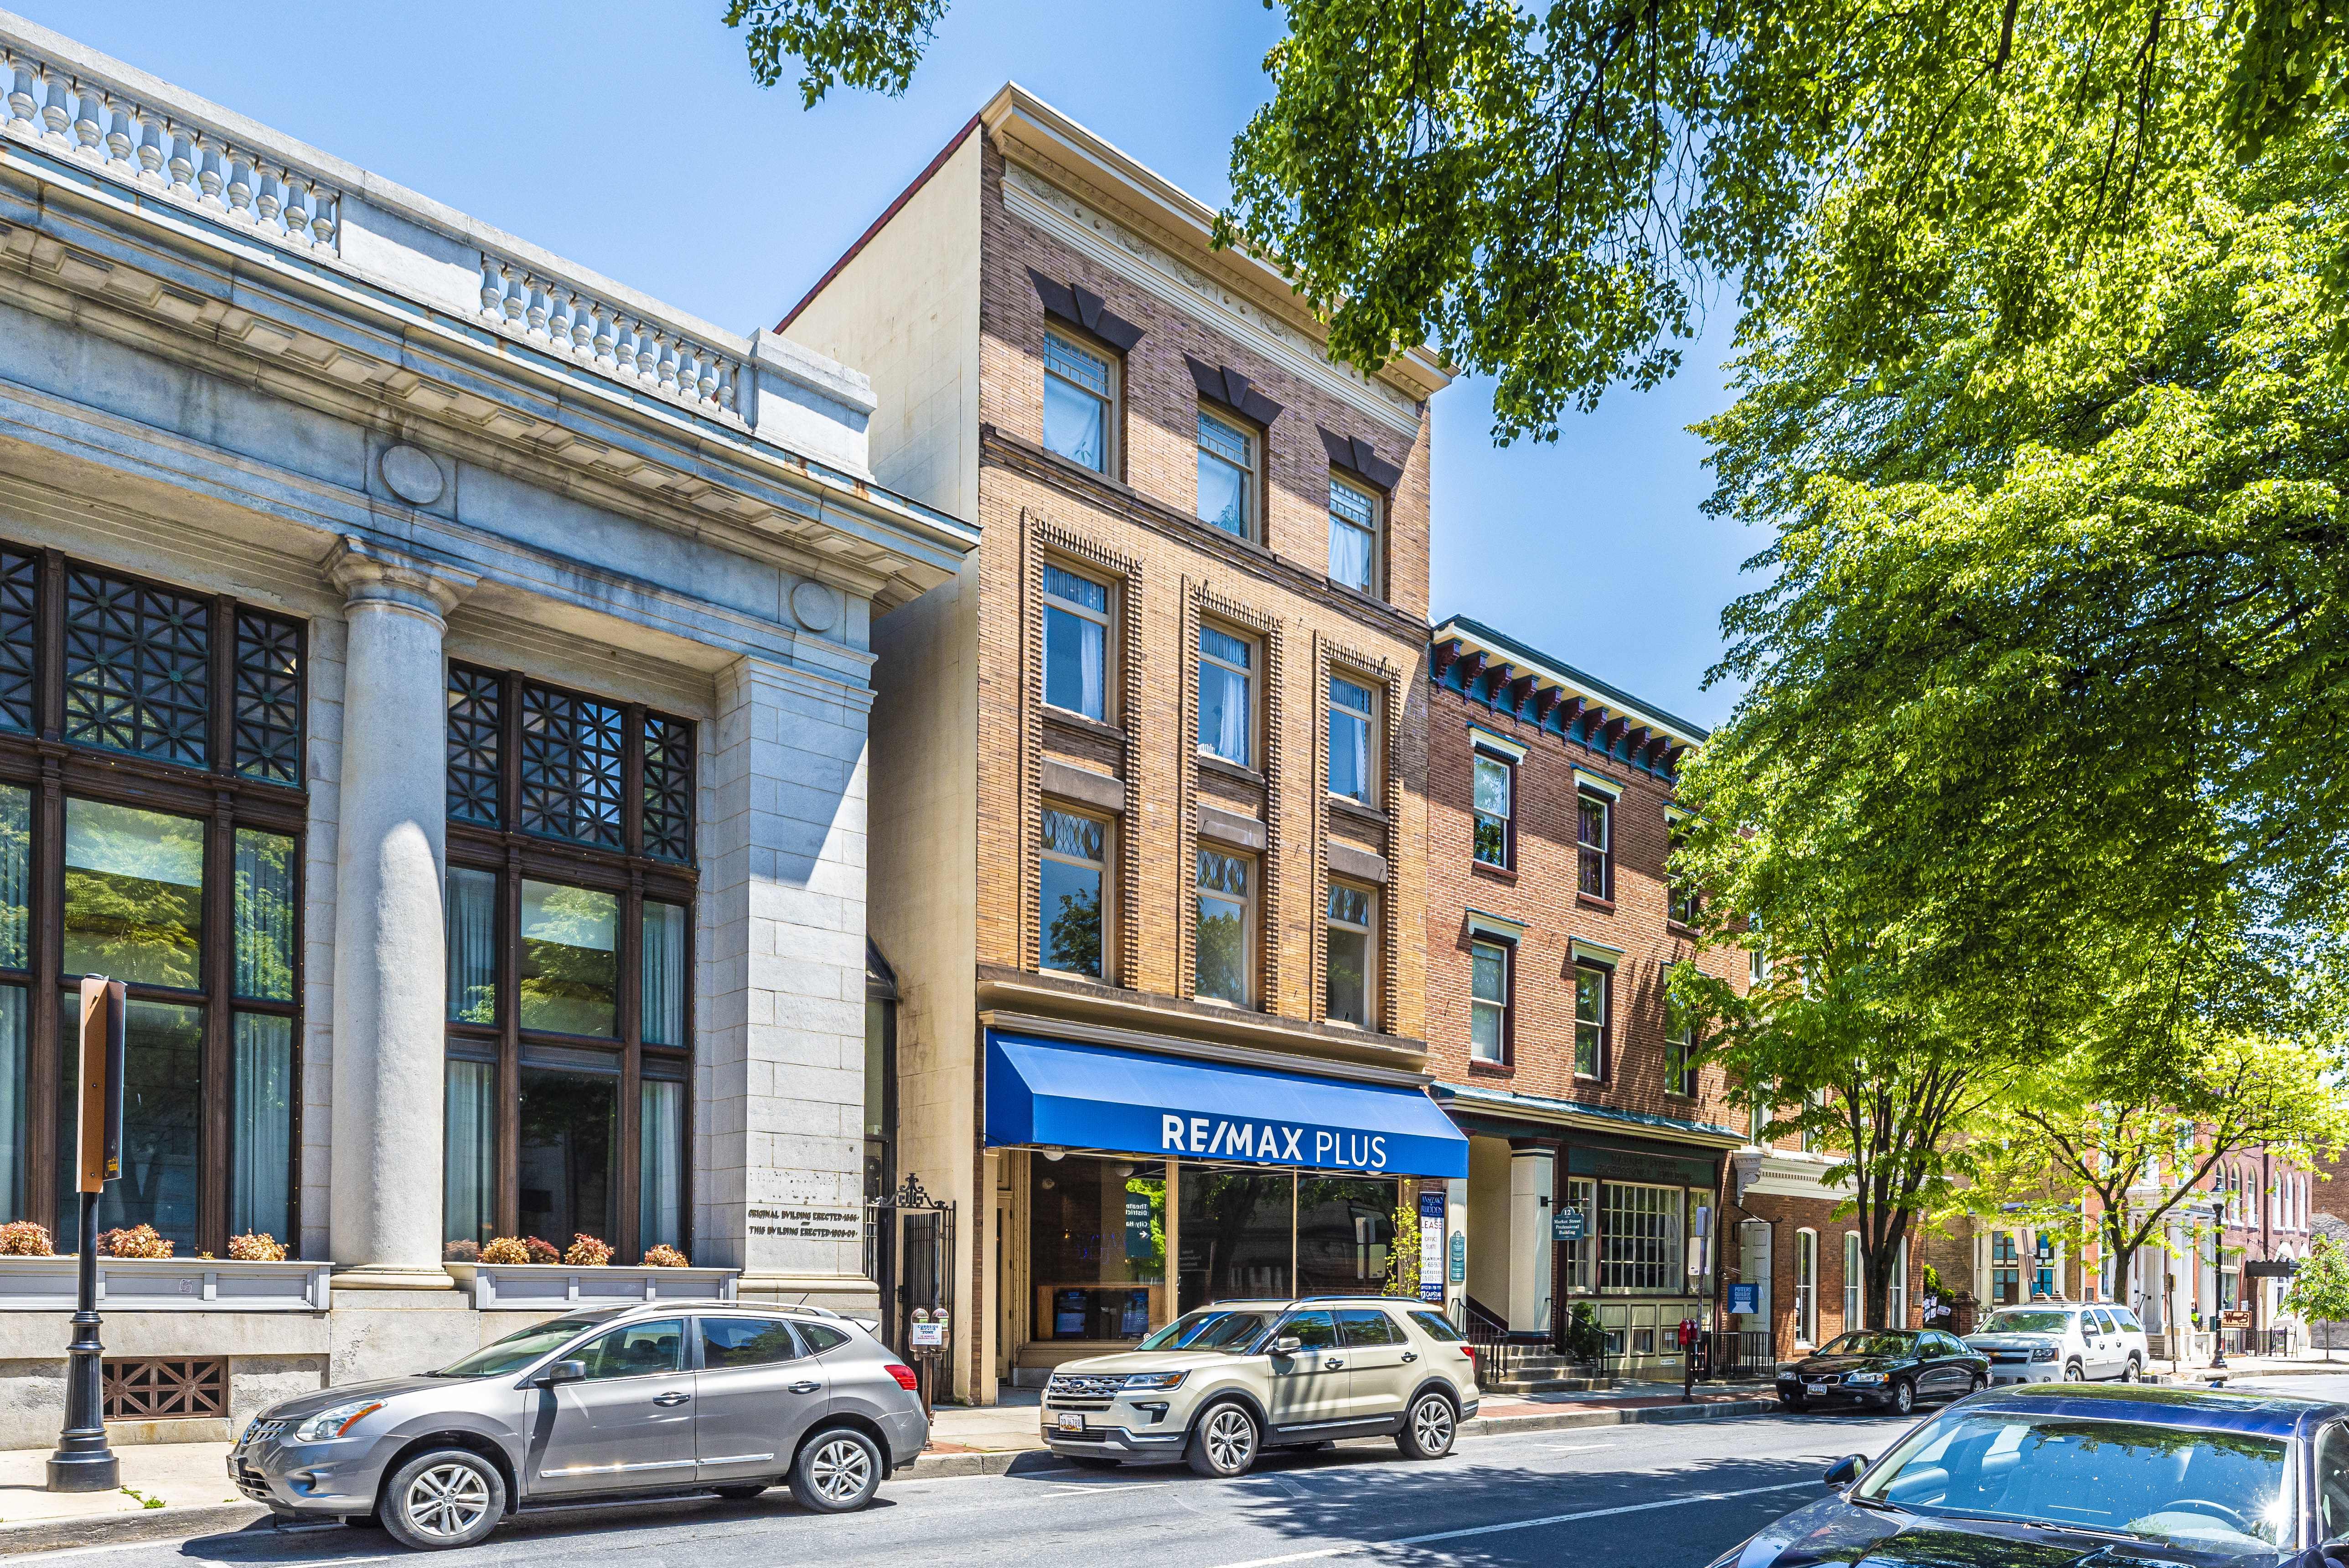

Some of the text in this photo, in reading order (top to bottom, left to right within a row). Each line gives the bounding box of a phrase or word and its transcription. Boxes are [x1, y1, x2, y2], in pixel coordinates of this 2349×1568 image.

[1163, 1114, 1386, 1168] RE/MAX PLUS
[748, 1209, 780, 1220] ORIGINAL
[813, 1212, 842, 1221] ERECTED
[749, 1226, 765, 1235] THIS
[800, 1228, 830, 1237] ERECTED
